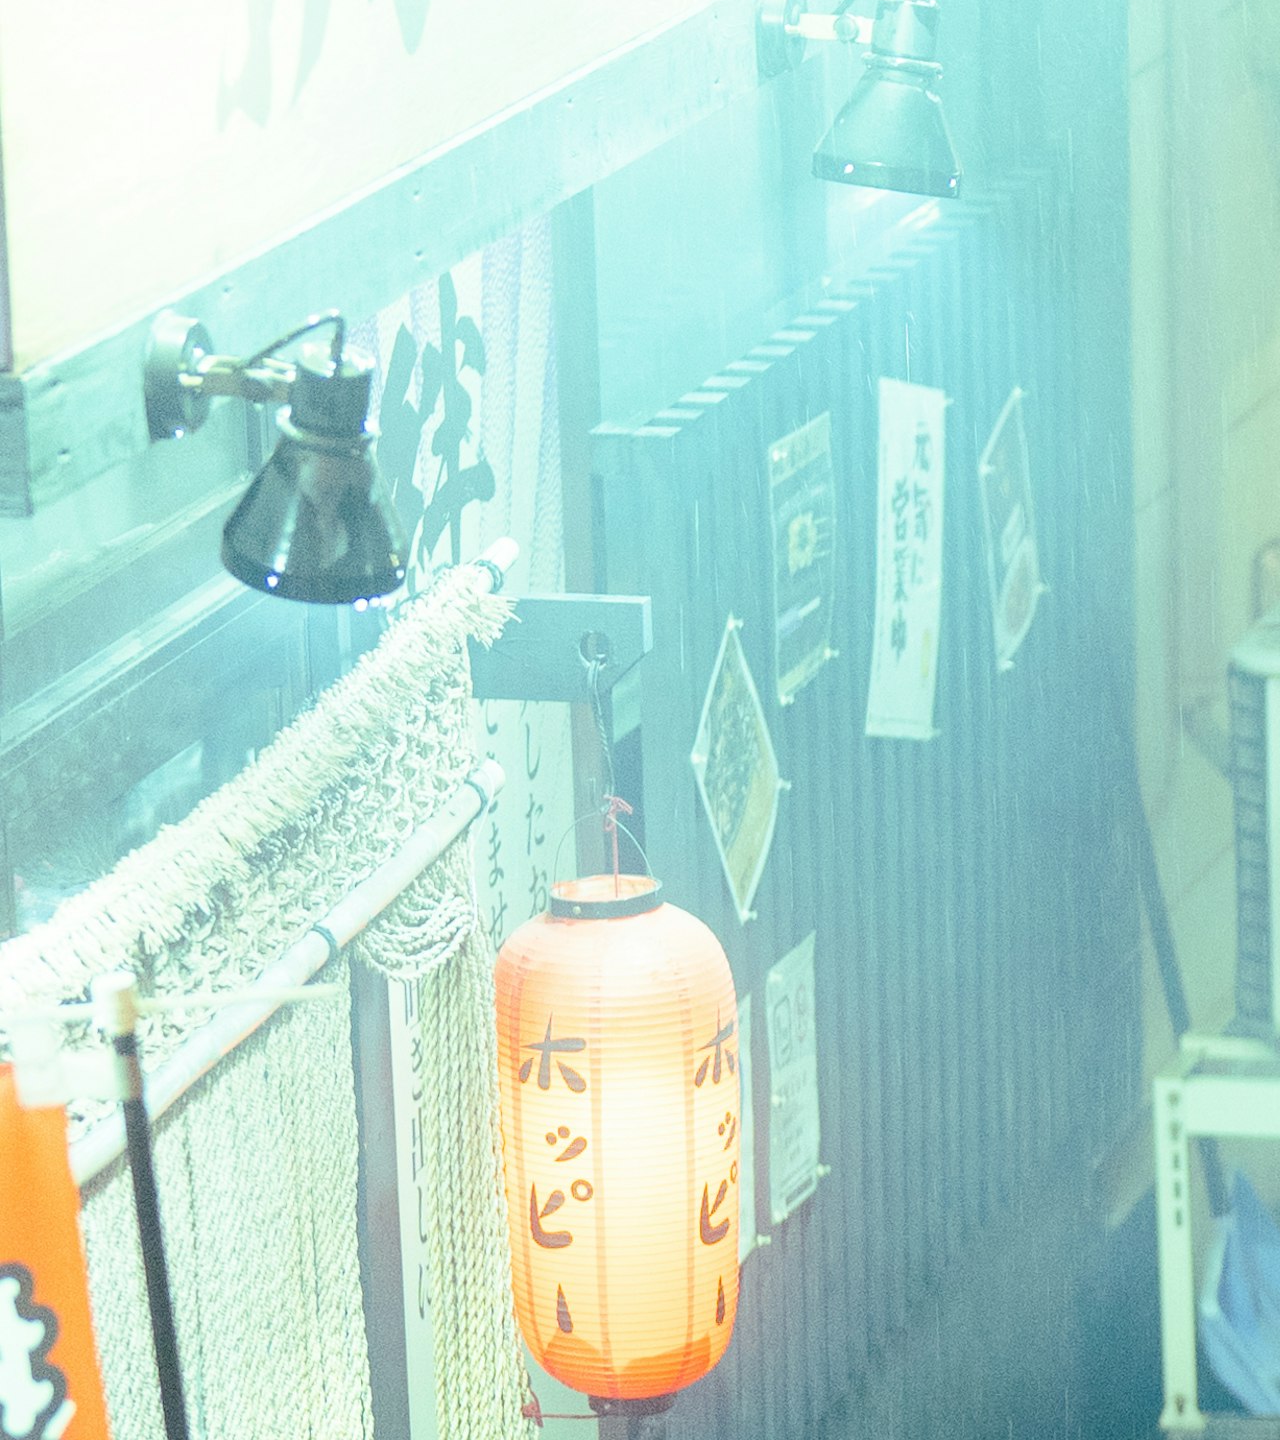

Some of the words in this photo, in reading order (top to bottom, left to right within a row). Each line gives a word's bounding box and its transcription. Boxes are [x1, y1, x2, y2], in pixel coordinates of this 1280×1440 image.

[519, 1011, 593, 1334] ホッピー
[695, 1004, 738, 1326] ホッピー
